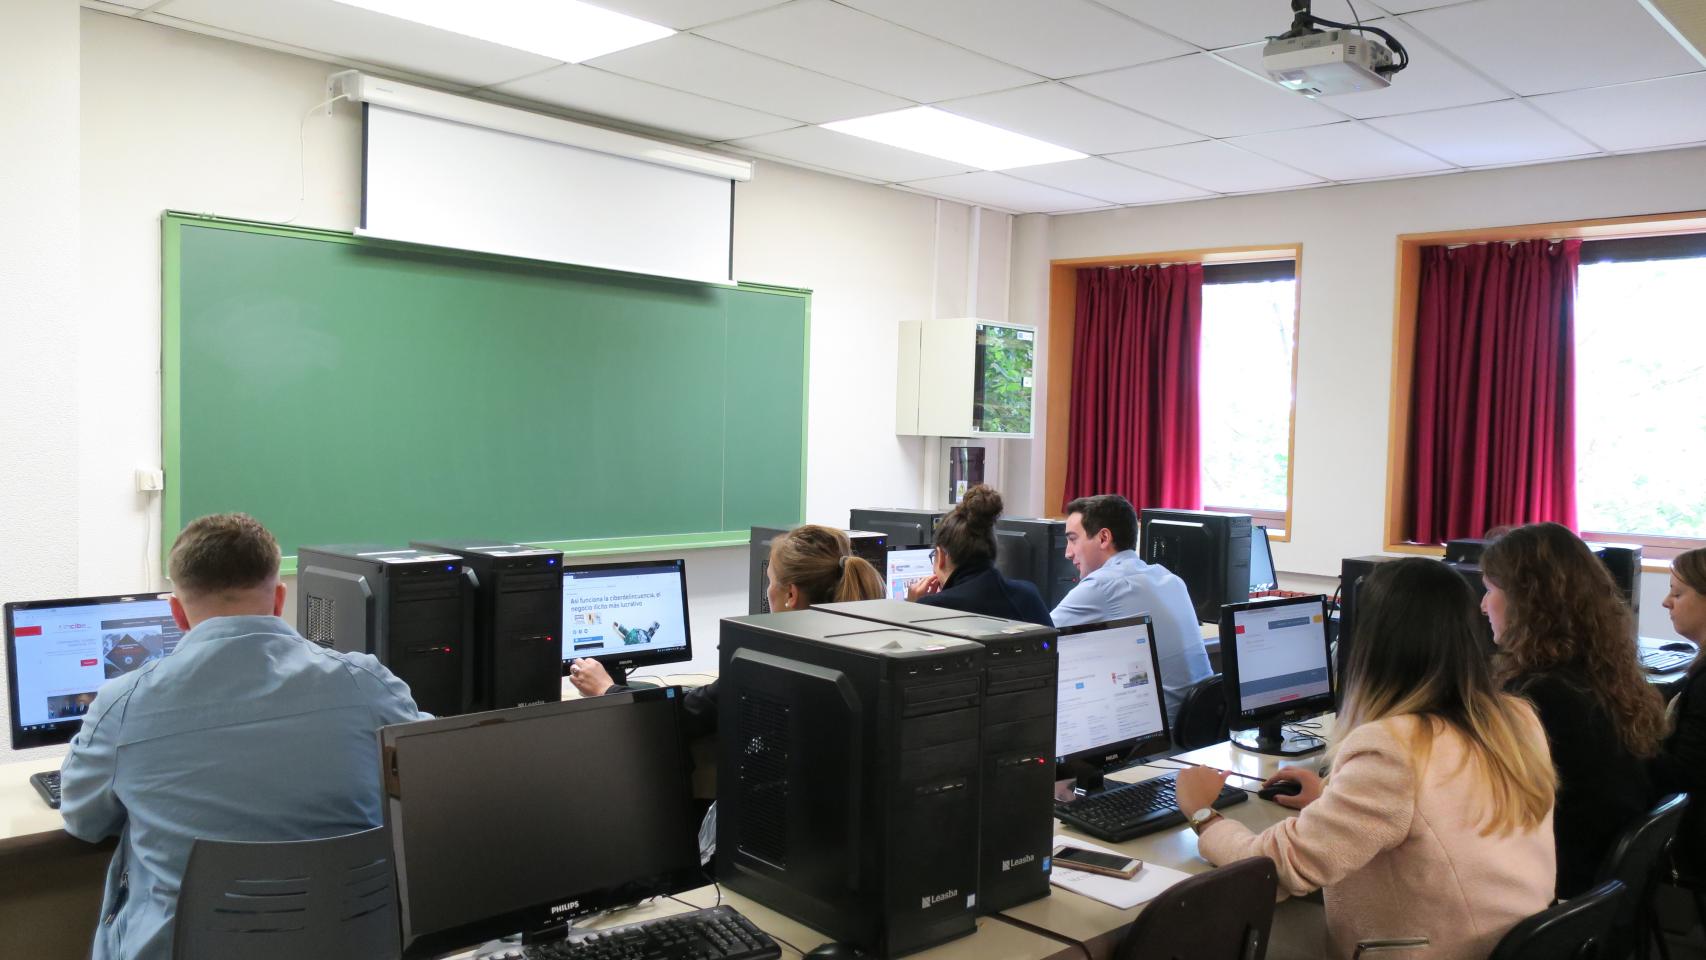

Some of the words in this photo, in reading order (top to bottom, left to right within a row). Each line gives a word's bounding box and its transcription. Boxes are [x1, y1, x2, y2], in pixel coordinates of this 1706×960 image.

[580, 596, 603, 604] funciona
[571, 605, 592, 613] negocio
[1010, 854, 1035, 867] Leasba
[931, 889, 958, 904] Leasba
[551, 900, 580, 915] PHILIPS
